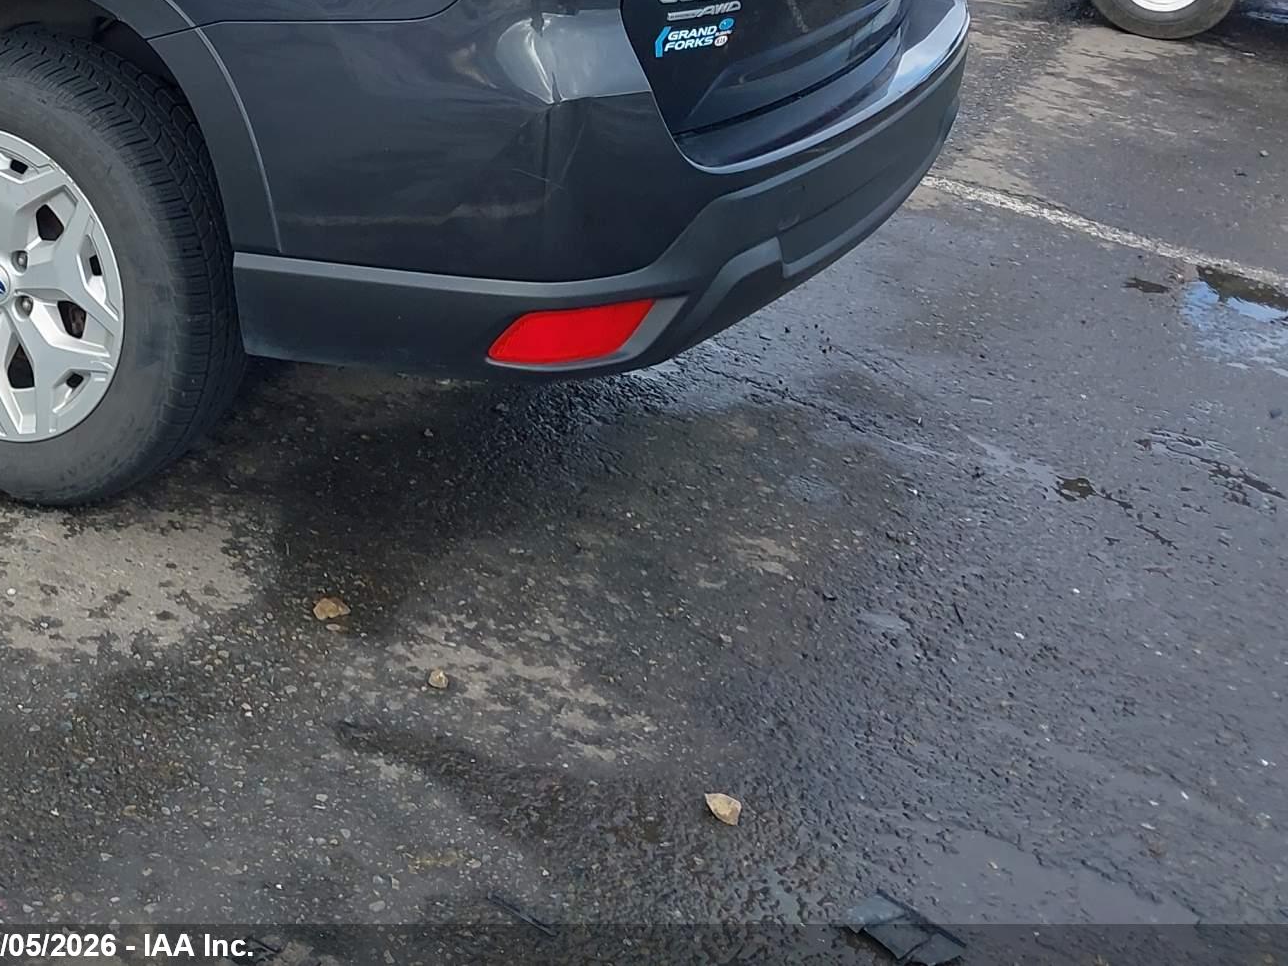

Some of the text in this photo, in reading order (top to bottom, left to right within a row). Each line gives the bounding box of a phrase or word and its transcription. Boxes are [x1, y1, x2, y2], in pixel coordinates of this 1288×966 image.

[697, 0, 742, 18] AWD
[667, 25, 718, 41] GRAND
[664, 35, 715, 52] FORKS
